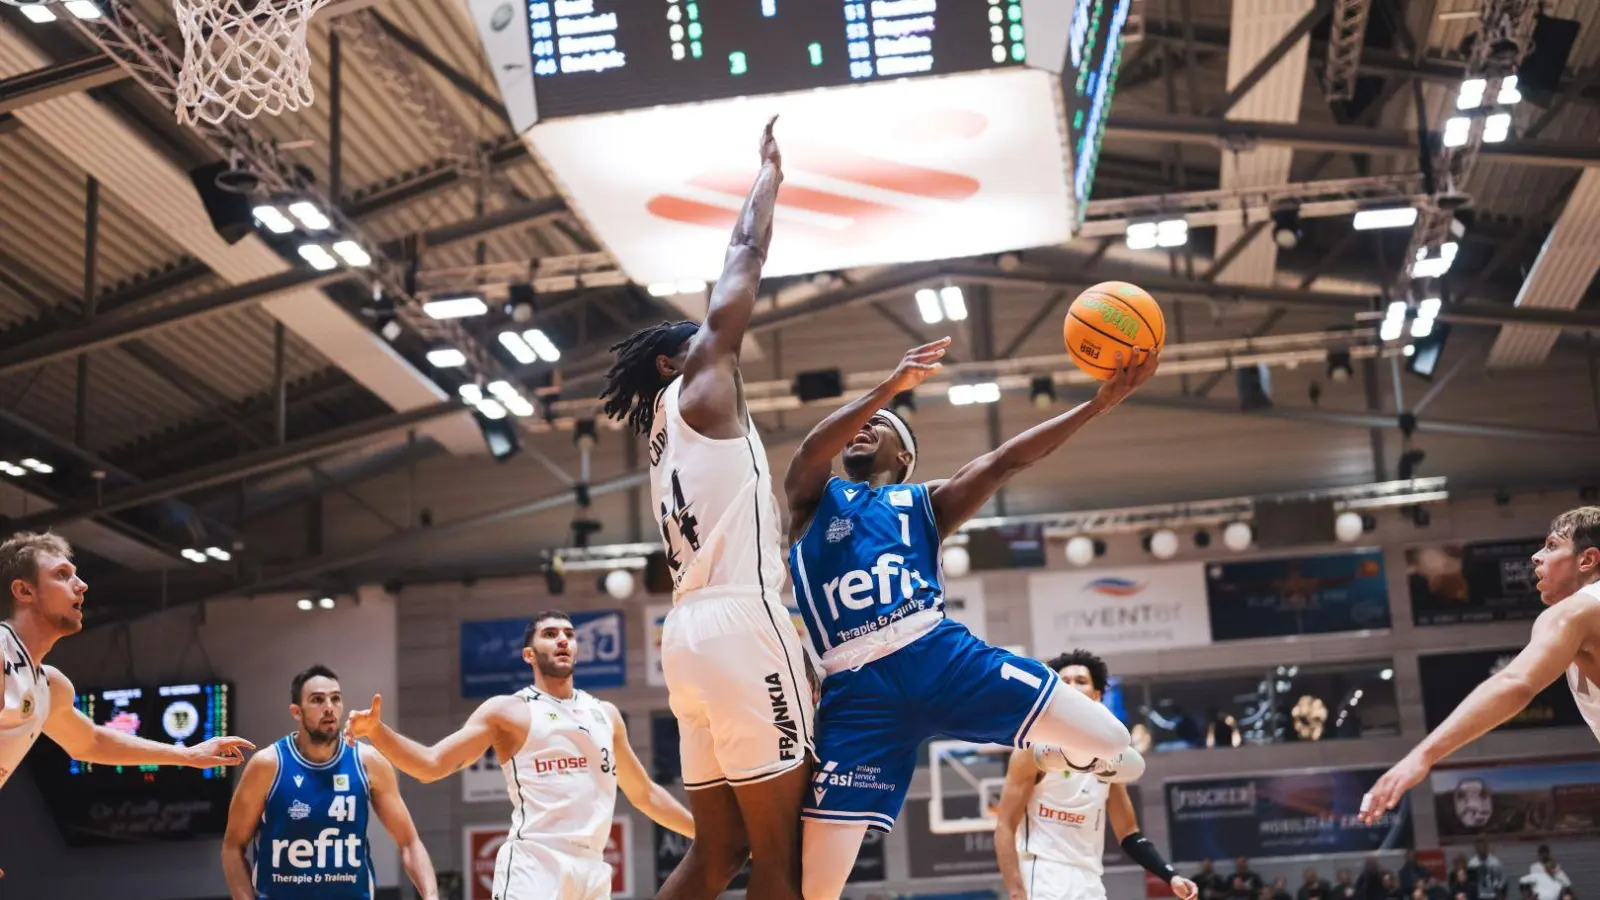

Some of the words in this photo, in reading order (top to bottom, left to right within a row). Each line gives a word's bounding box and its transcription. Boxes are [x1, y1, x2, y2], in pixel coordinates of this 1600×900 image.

[1080, 342, 1100, 360] FIBA
[898, 512, 912, 547] 1
[878, 615, 889, 626] &
[1001, 661, 1043, 690] 1
[765, 672, 798, 761] FRANKIA
[535, 756, 588, 773] brose
[856, 764, 881, 774] anlagen
[829, 772, 853, 787] asi
[854, 773, 876, 782] service
[327, 795, 357, 822] 41
[1038, 804, 1086, 824] brose
[272, 827, 362, 868] refit
[272, 873, 312, 885] Therapie
[314, 875, 322, 883] &
[324, 873, 357, 884] Training
